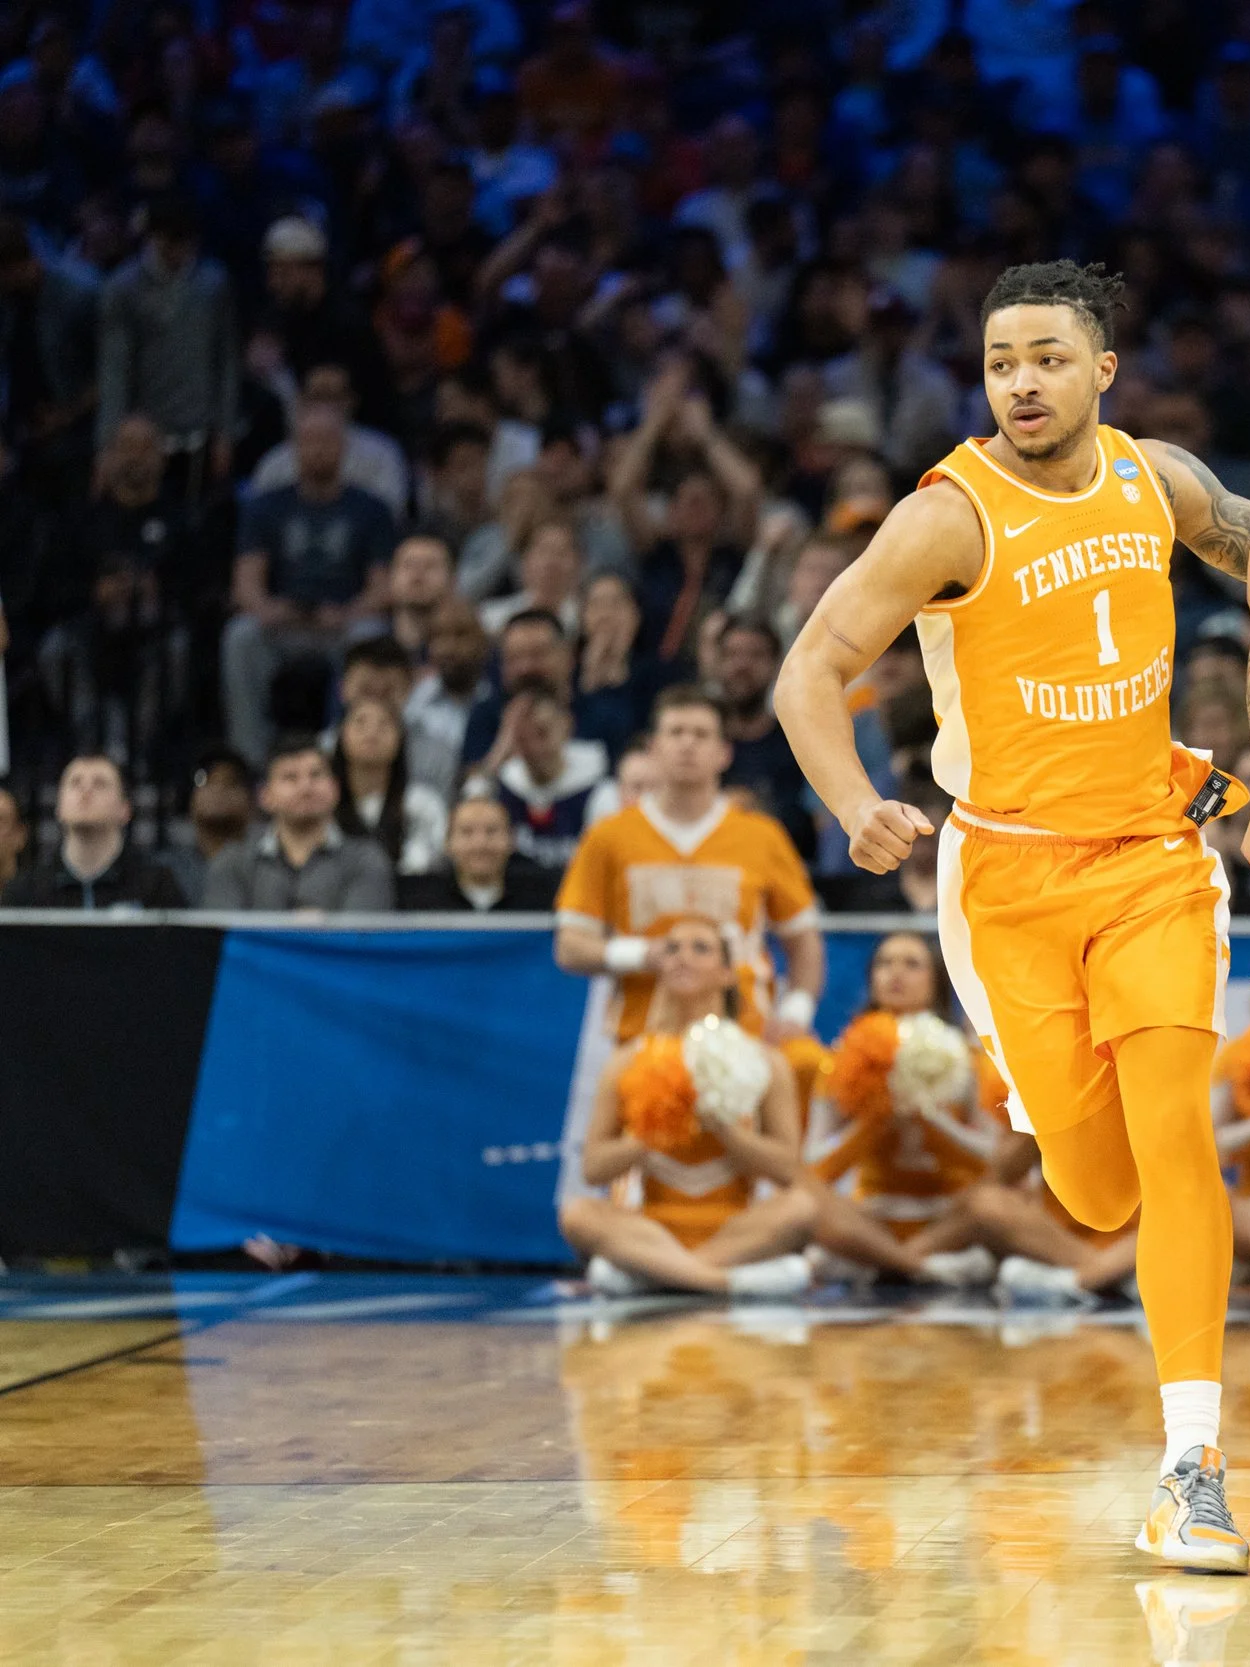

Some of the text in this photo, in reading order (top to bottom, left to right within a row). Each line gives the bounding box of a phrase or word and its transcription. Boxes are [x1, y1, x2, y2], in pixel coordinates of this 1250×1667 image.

[1014, 533, 1162, 606] TENNESSEE
[1093, 589, 1120, 666] 1
[1016, 646, 1170, 722] VOLUNTEERS
[1211, 779, 1222, 790] 46
